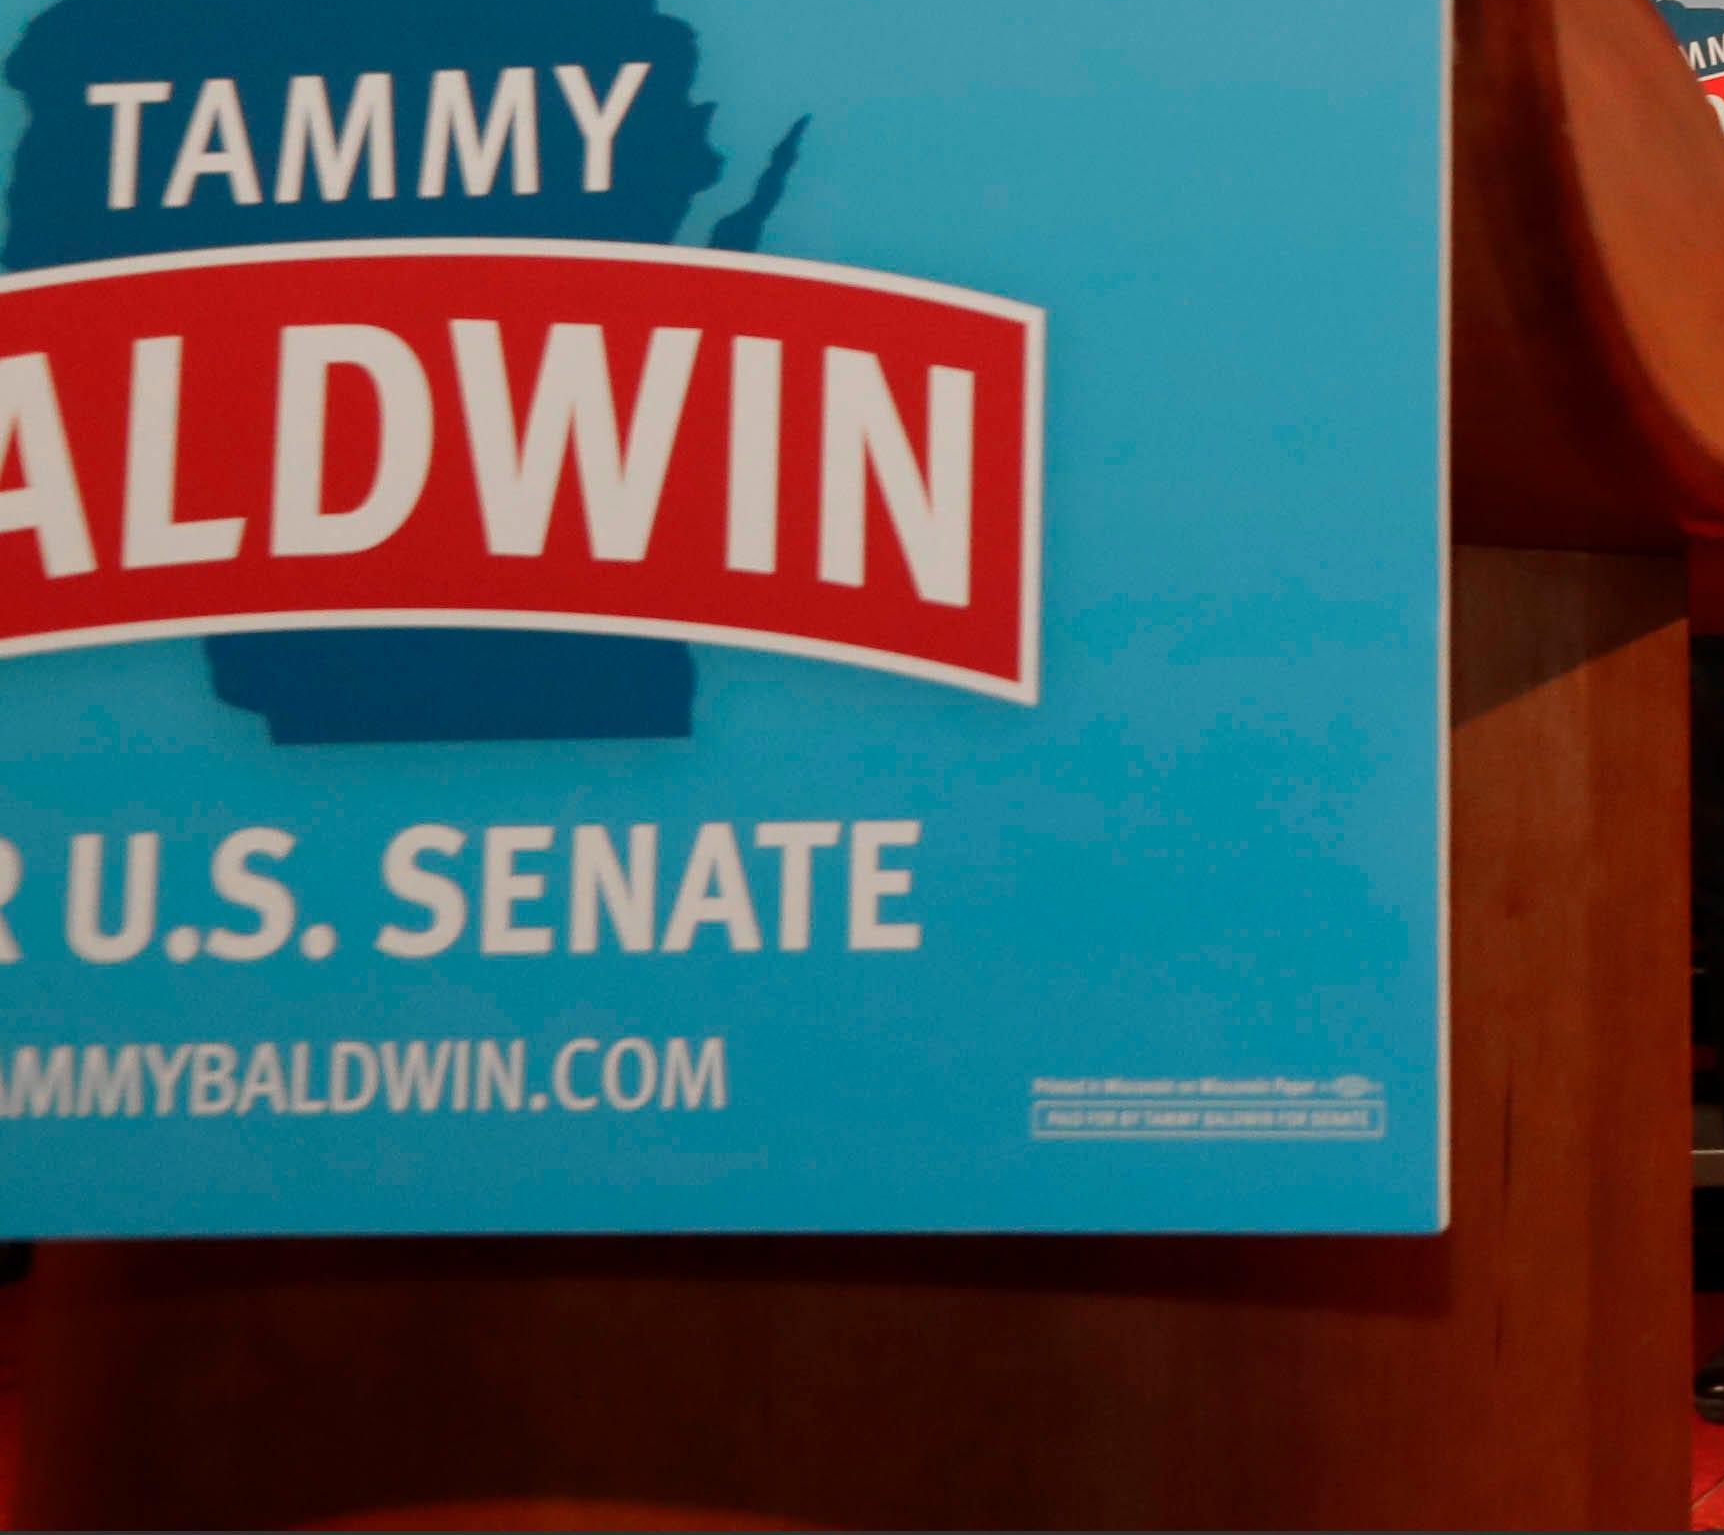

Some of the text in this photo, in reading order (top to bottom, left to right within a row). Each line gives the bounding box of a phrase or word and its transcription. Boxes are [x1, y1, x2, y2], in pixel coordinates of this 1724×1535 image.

[85, 62, 652, 209] TAMMY
[0, 318, 976, 610] ALDWIN
[65, 826, 338, 964] U.S.
[373, 819, 924, 958] SENATE
[0, 1037, 729, 1120] MMYBALDWIN.COM
